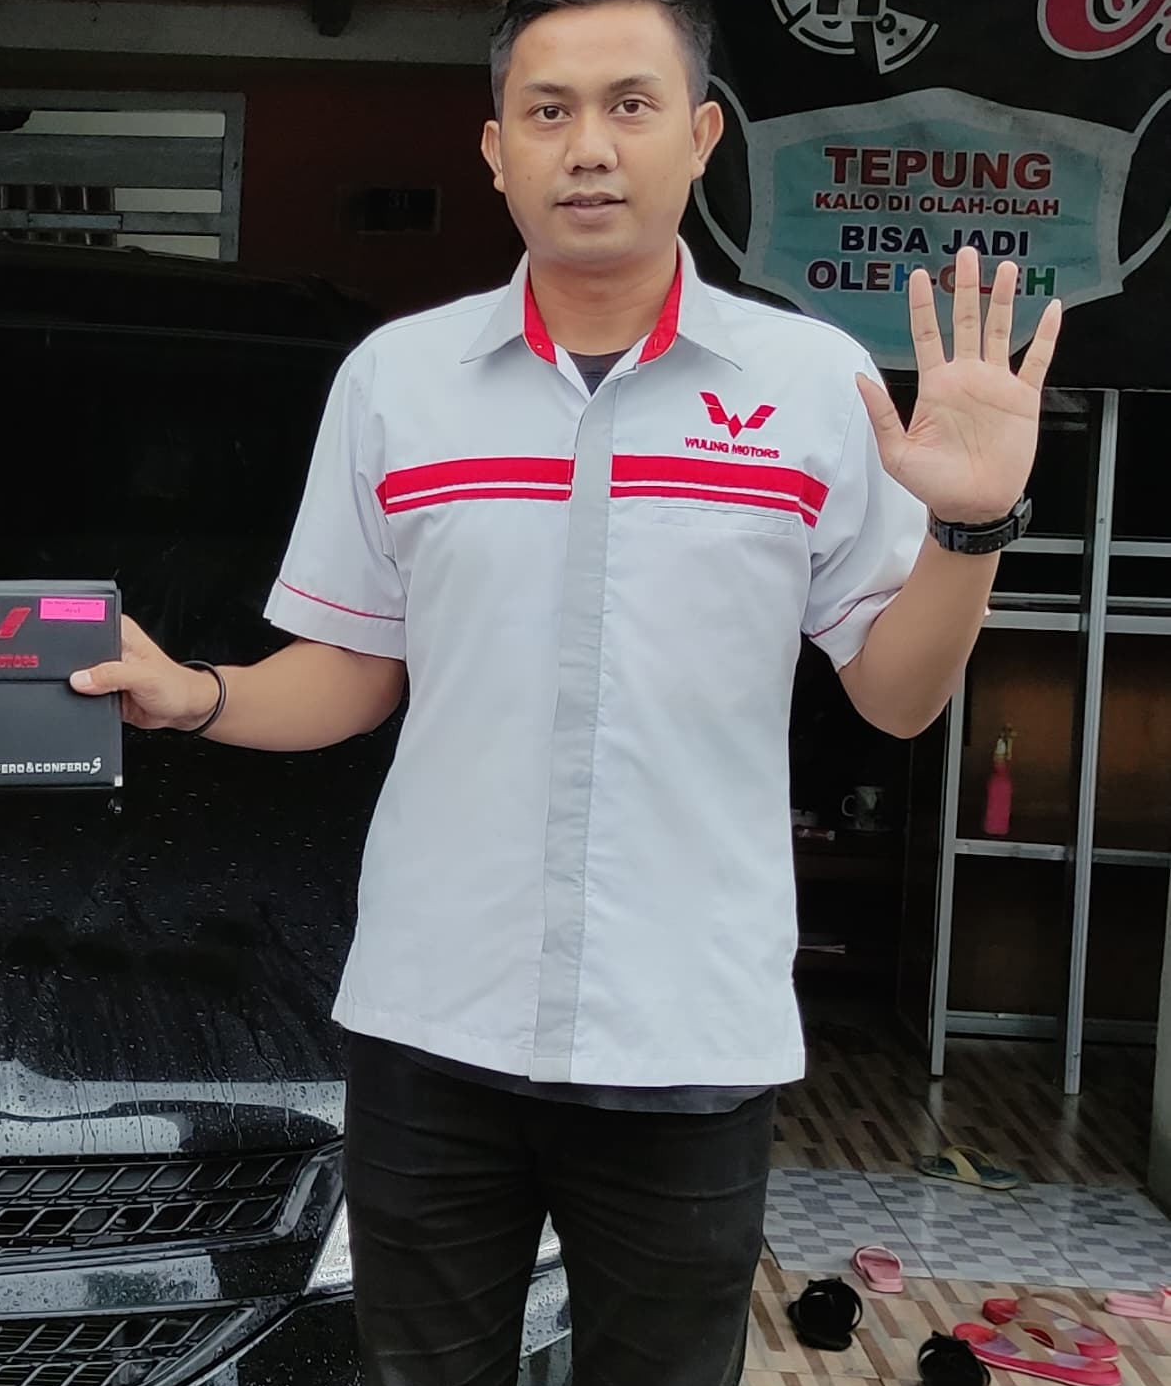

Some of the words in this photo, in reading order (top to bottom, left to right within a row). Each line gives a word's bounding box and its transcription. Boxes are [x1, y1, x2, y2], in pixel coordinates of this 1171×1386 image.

[824, 146, 1052, 190] TEPUNG
[815, 192, 879, 211] KALO
[888, 195, 910, 211] DI
[919, 196, 1060, 216] OLAH-OLAH
[840, 225, 929, 254] BISA
[942, 229, 1029, 257] JADI
[684, 437, 730, 454] WULING
[731, 444, 781, 460] MOTORS
